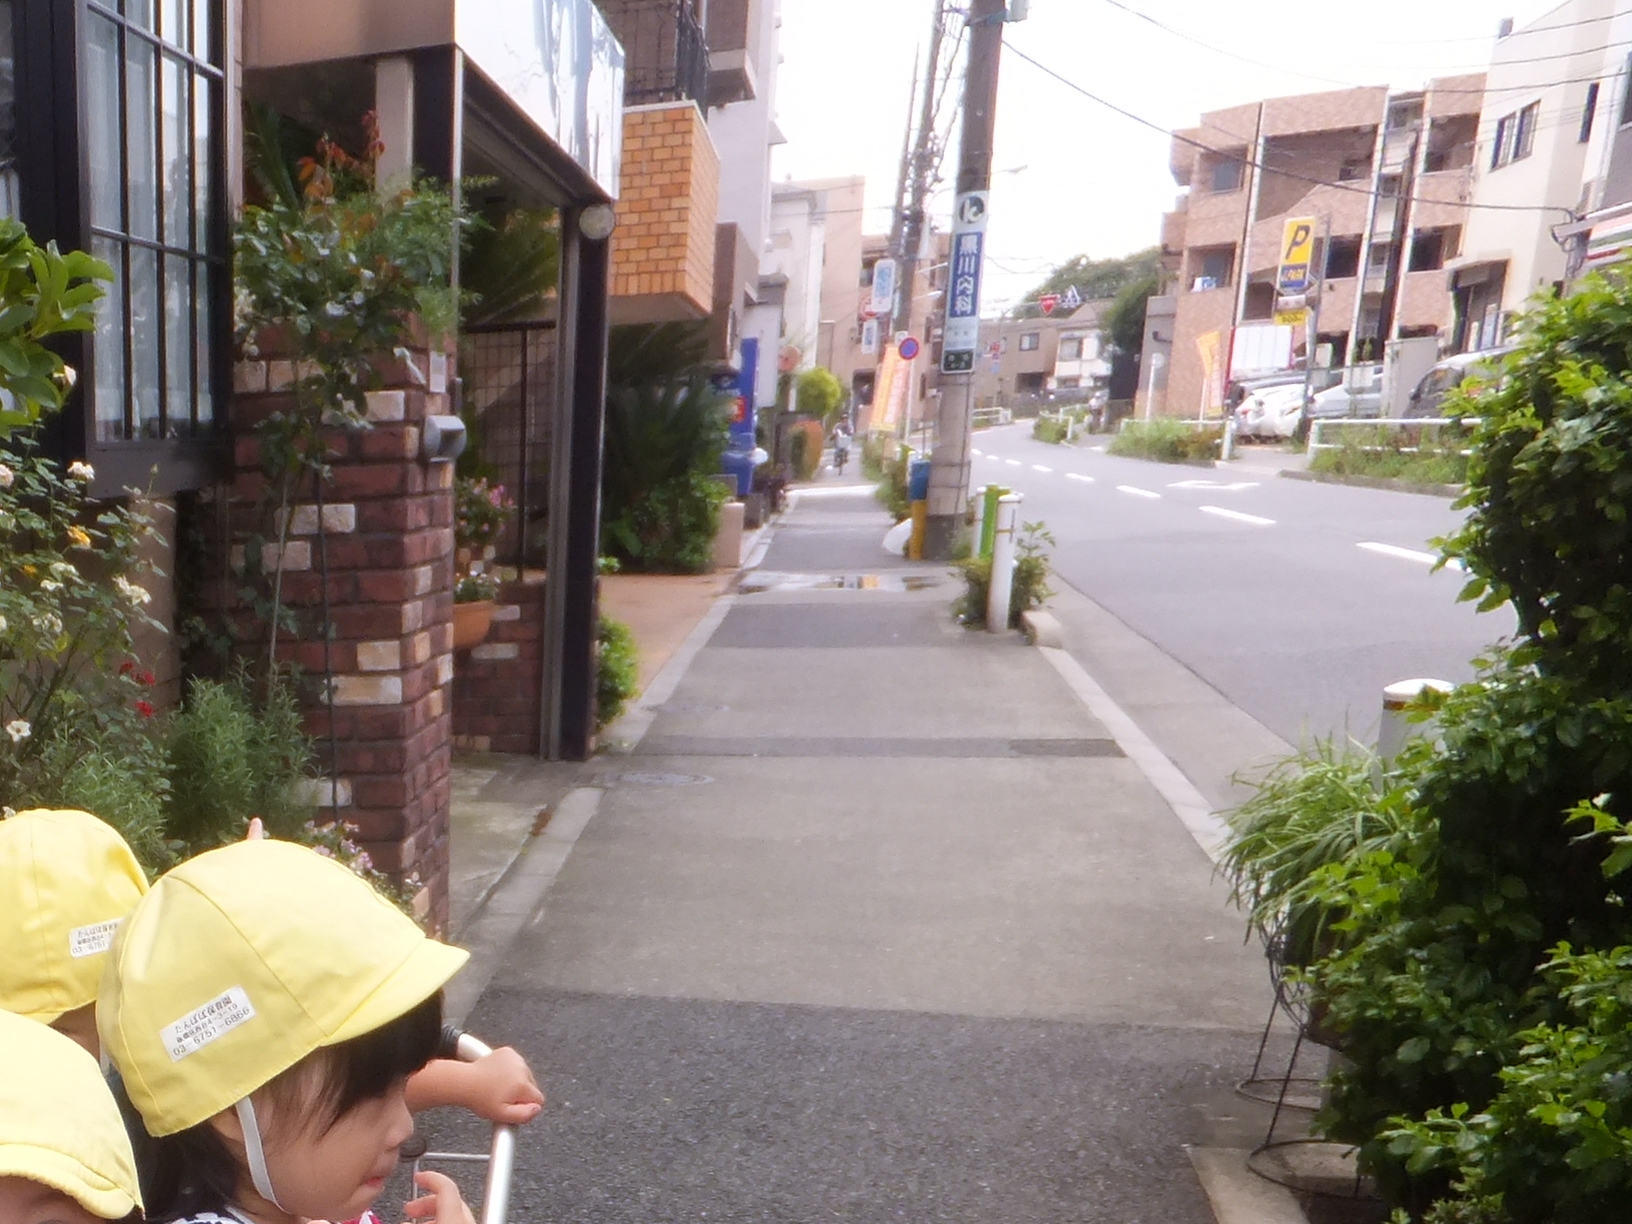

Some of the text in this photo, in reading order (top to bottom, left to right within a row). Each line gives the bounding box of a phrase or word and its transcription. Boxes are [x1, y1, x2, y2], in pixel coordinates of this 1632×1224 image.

[1285, 225, 1311, 260] P
[954, 235, 979, 315] 黒川内科
[172, 1007, 250, 1056] 03-6751-6866
[175, 995, 232, 1033] たんぽぽ保育園
